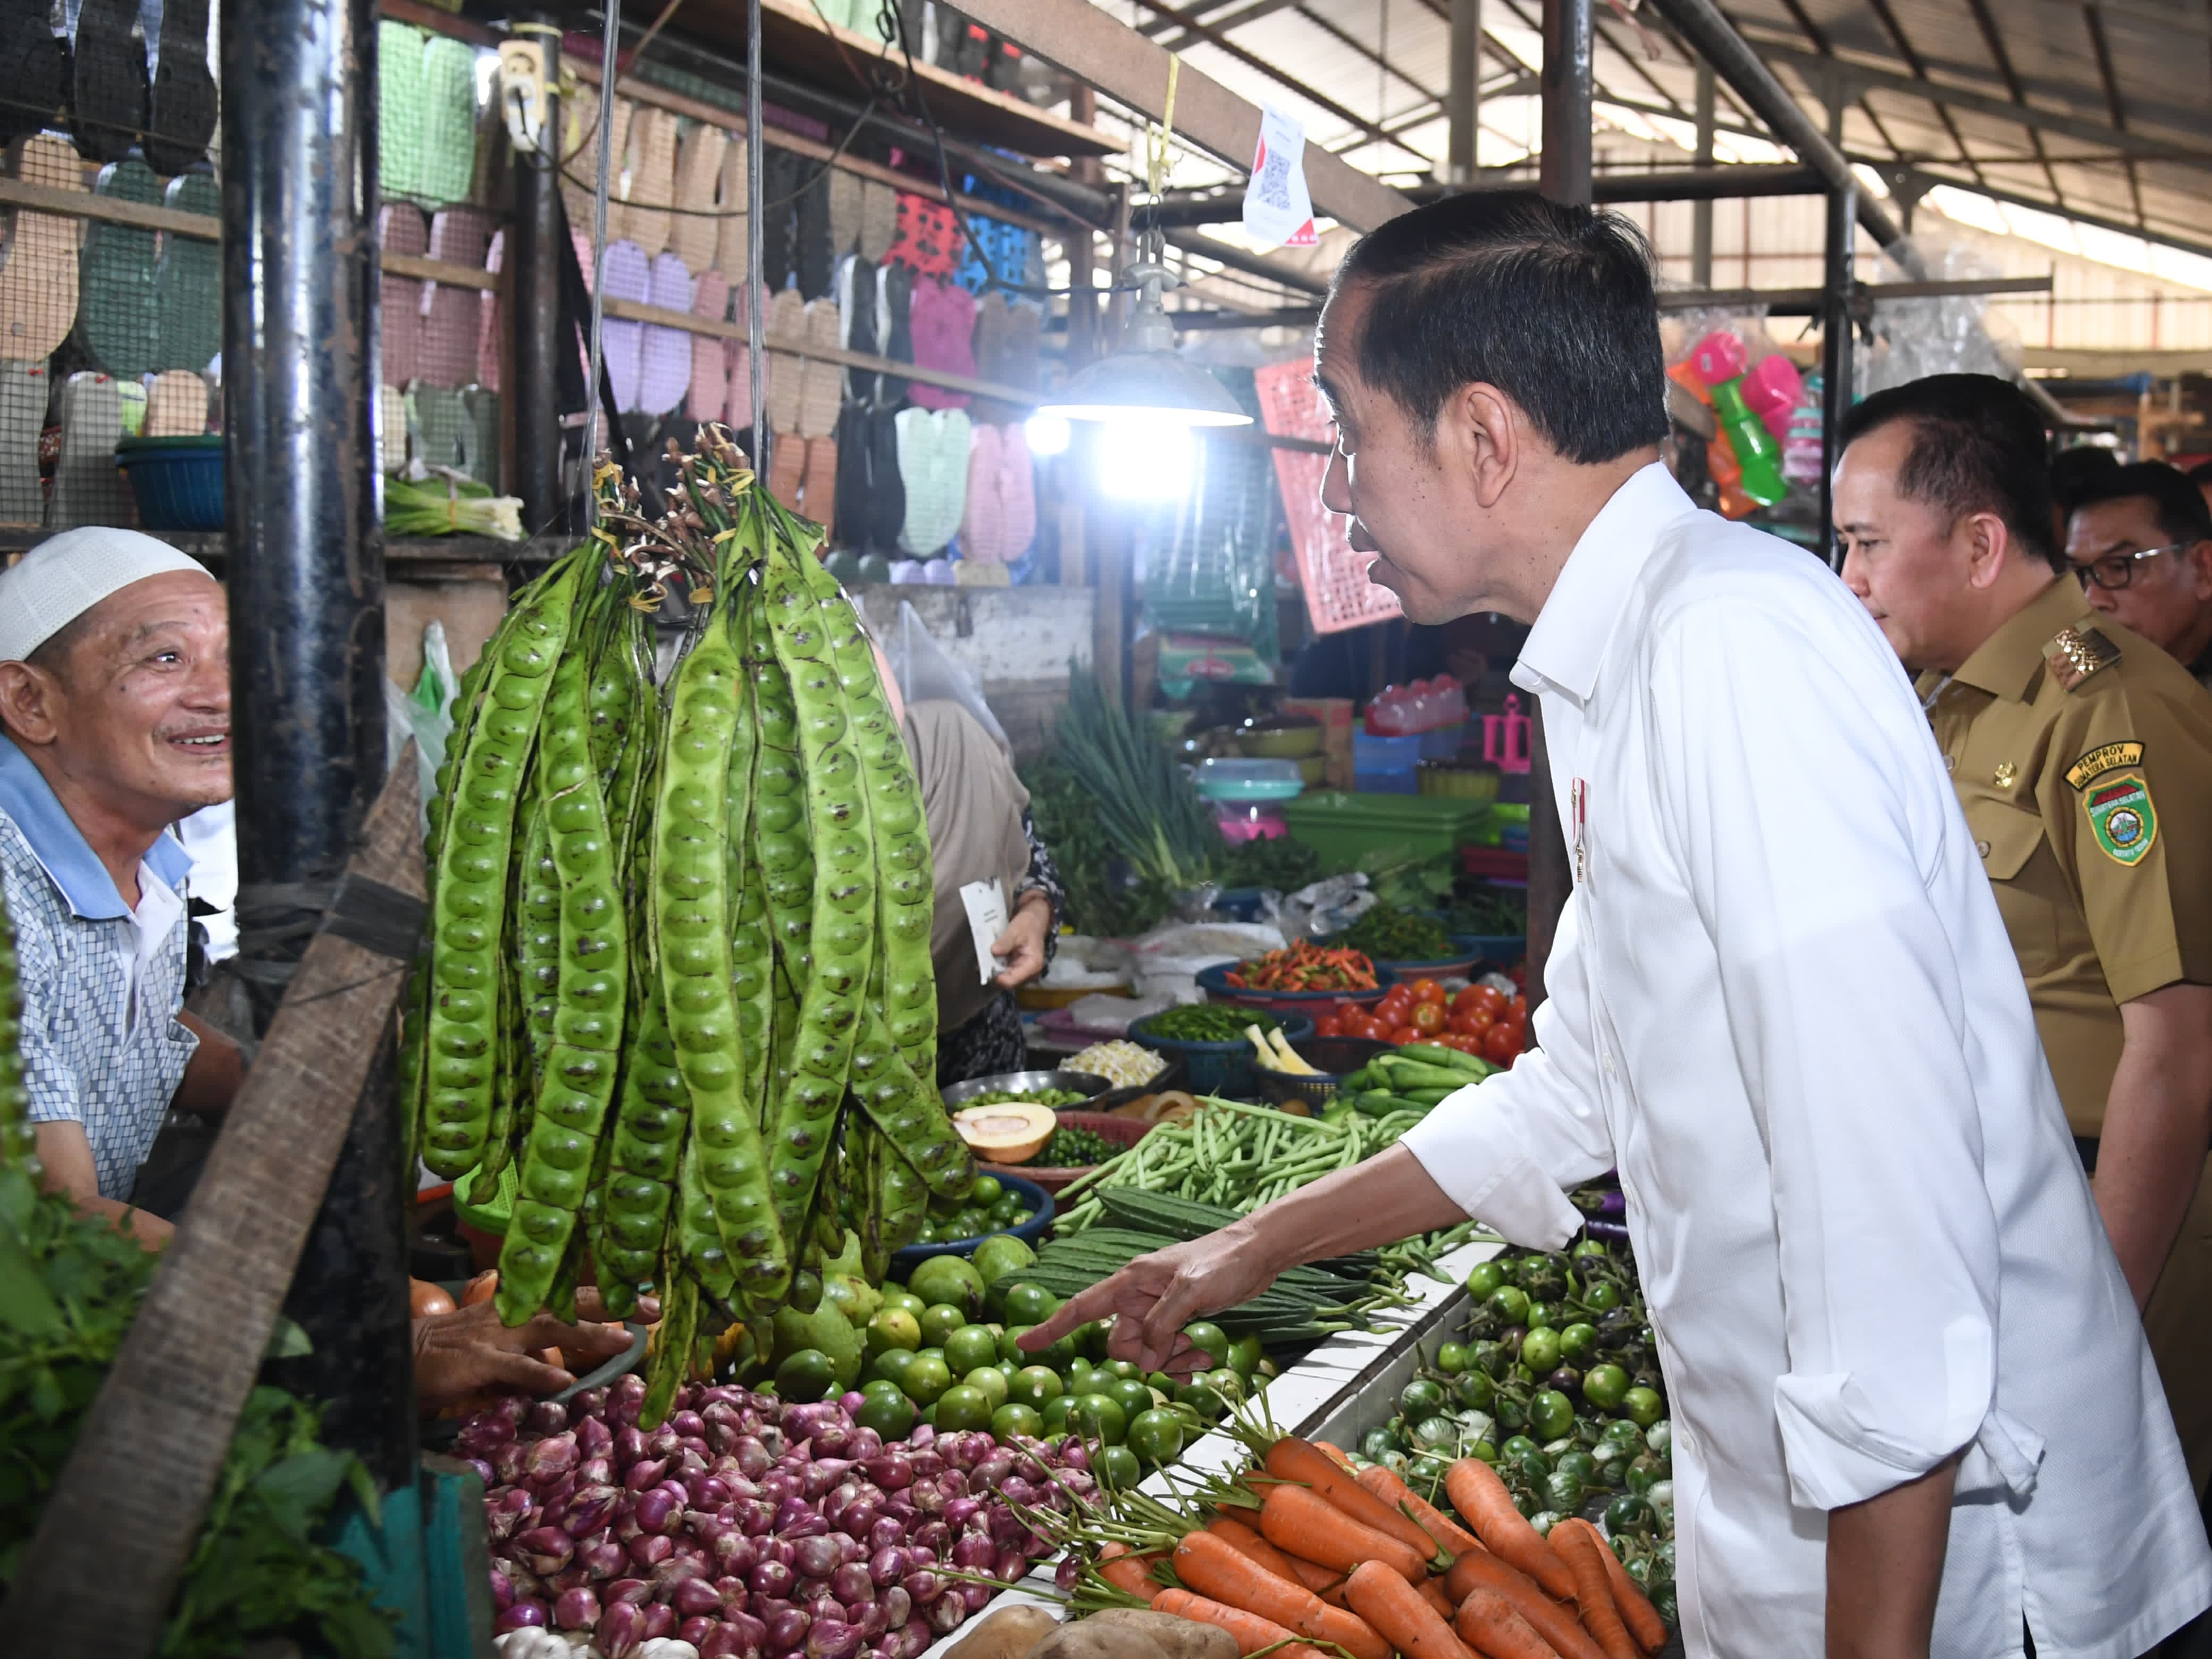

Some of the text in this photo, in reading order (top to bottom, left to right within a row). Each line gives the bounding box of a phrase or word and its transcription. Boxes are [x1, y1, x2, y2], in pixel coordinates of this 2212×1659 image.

[2074, 755, 2136, 786] SUMATERA SELATAN
[2076, 744, 2124, 770] PEMPROV
